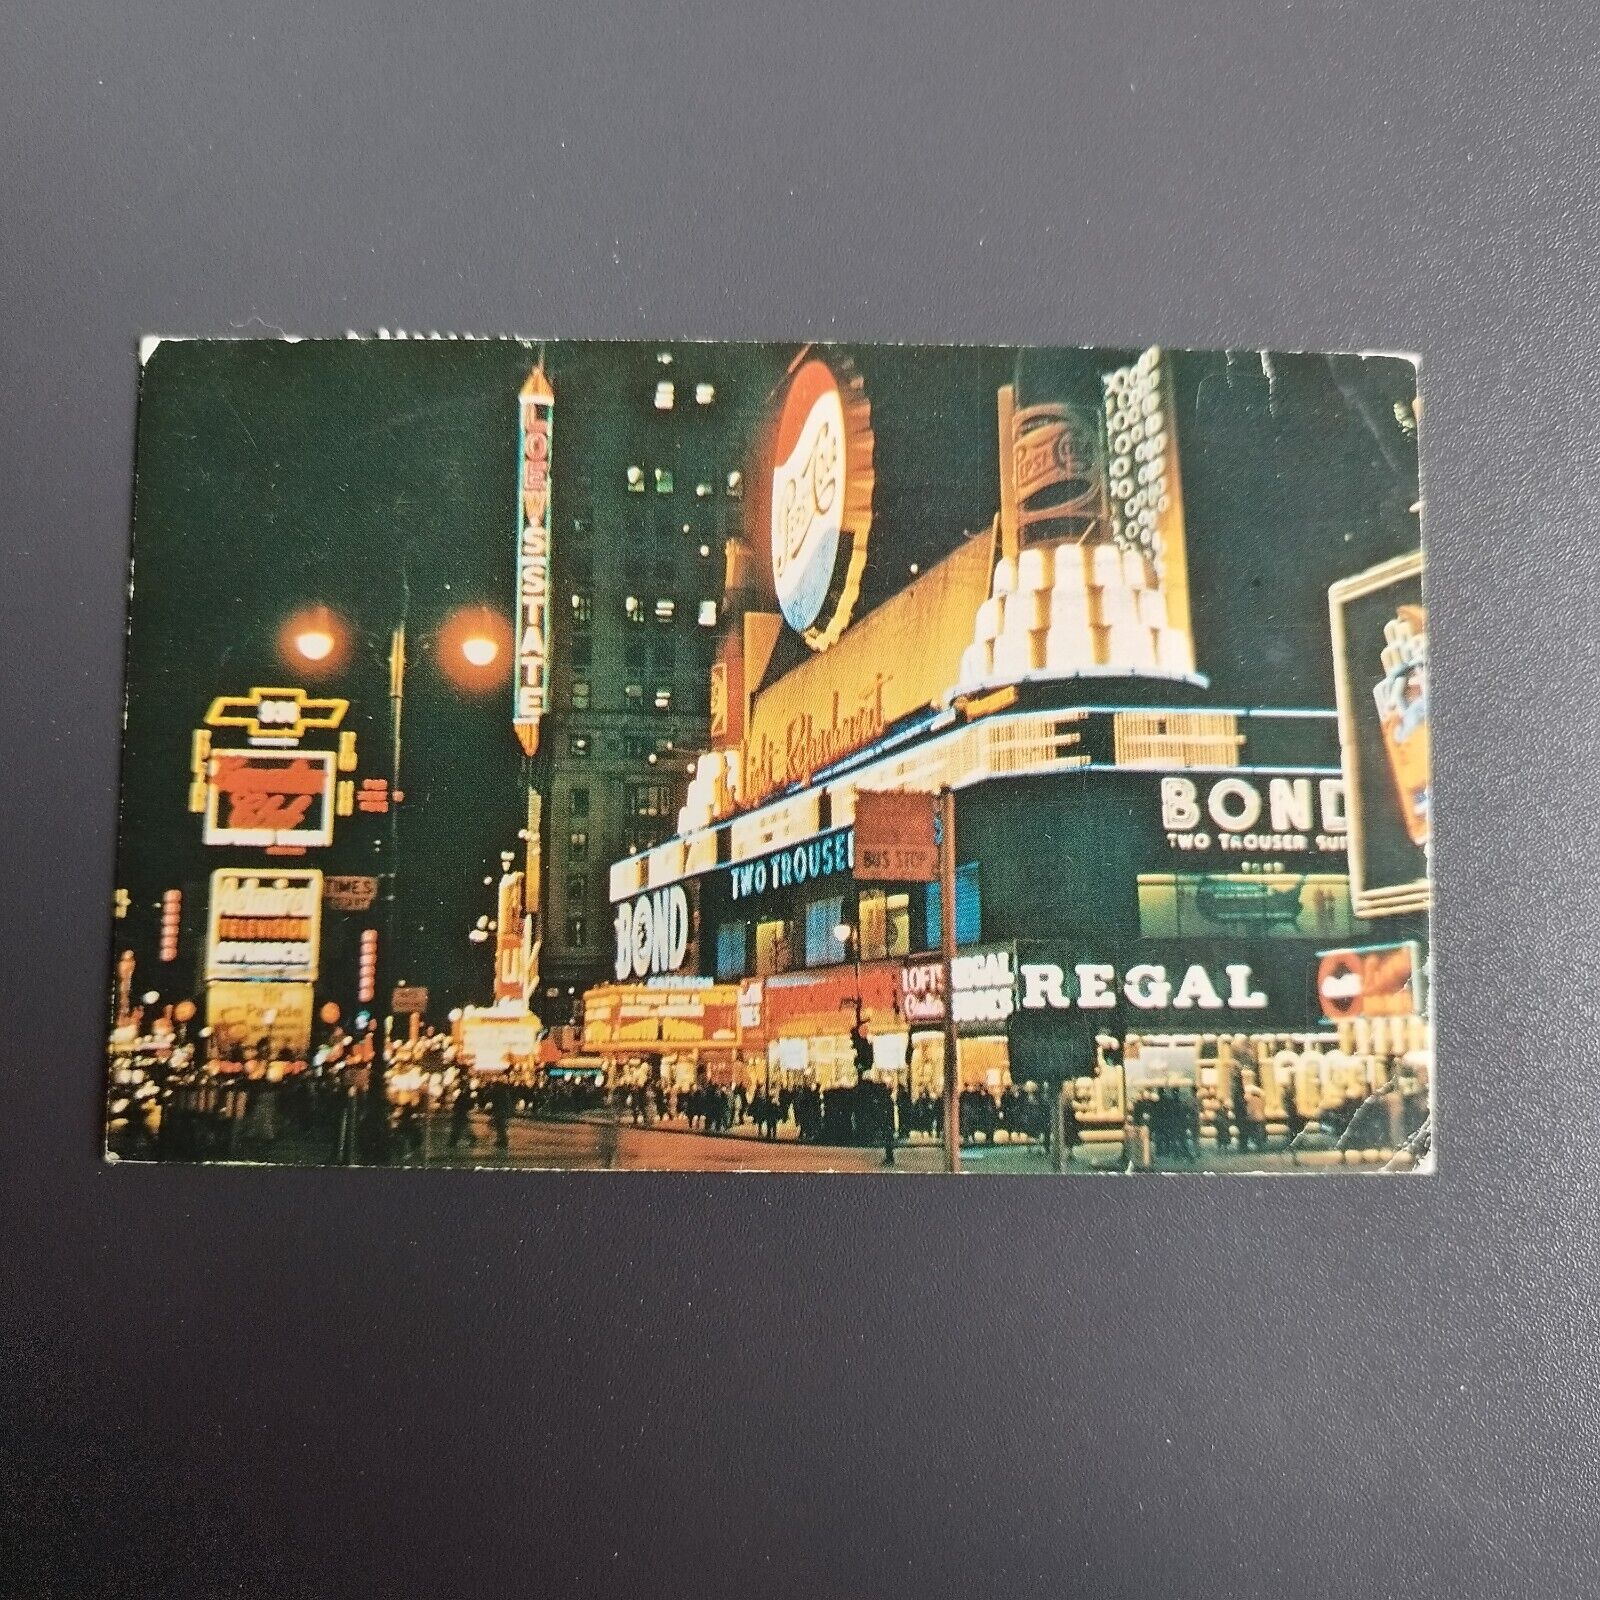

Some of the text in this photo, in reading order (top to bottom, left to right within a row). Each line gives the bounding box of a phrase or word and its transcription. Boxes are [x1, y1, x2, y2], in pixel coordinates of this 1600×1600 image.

[518, 566, 546, 717] STATE
[1160, 777, 1348, 832] BOND
[863, 849, 890, 868] BUS
[1166, 833, 1212, 849] TWO
[1217, 834, 1309, 850] TROUSER
[730, 860, 767, 900] TWO
[613, 884, 689, 980] BOND
[1020, 964, 1269, 1010] REGAL
